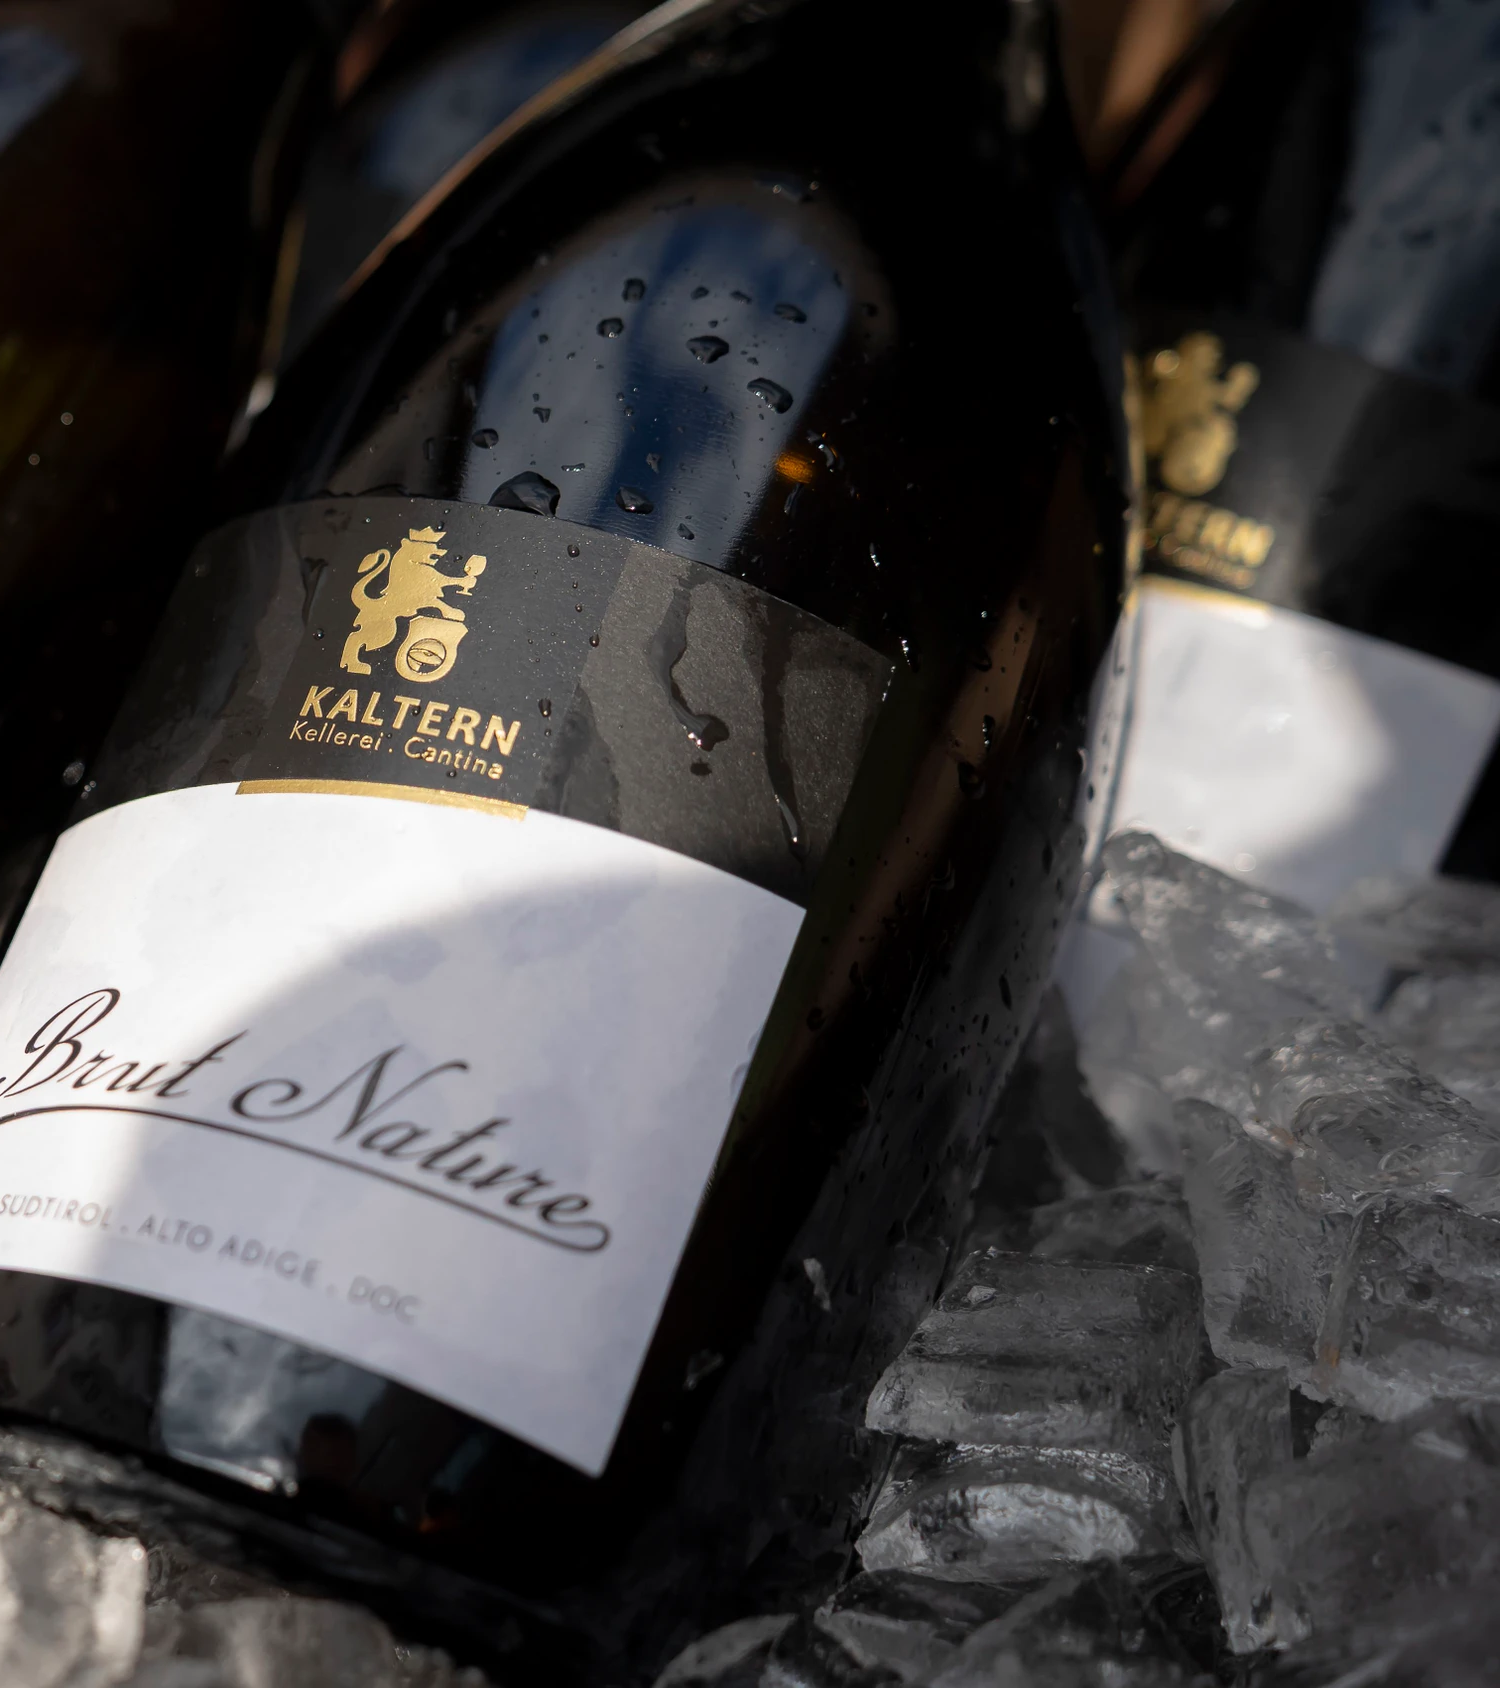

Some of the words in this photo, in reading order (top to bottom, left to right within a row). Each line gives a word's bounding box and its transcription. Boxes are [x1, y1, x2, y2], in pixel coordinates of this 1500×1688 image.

[289, 720, 384, 751] Kellerei
[403, 736, 505, 780] Cantina
[299, 685, 522, 756] KALTERN
[231, 1044, 610, 1230] Nature
[136, 1213, 213, 1254] ALTO
[217, 1234, 321, 1289] ADIGE
[348, 1275, 421, 1325] DOC
